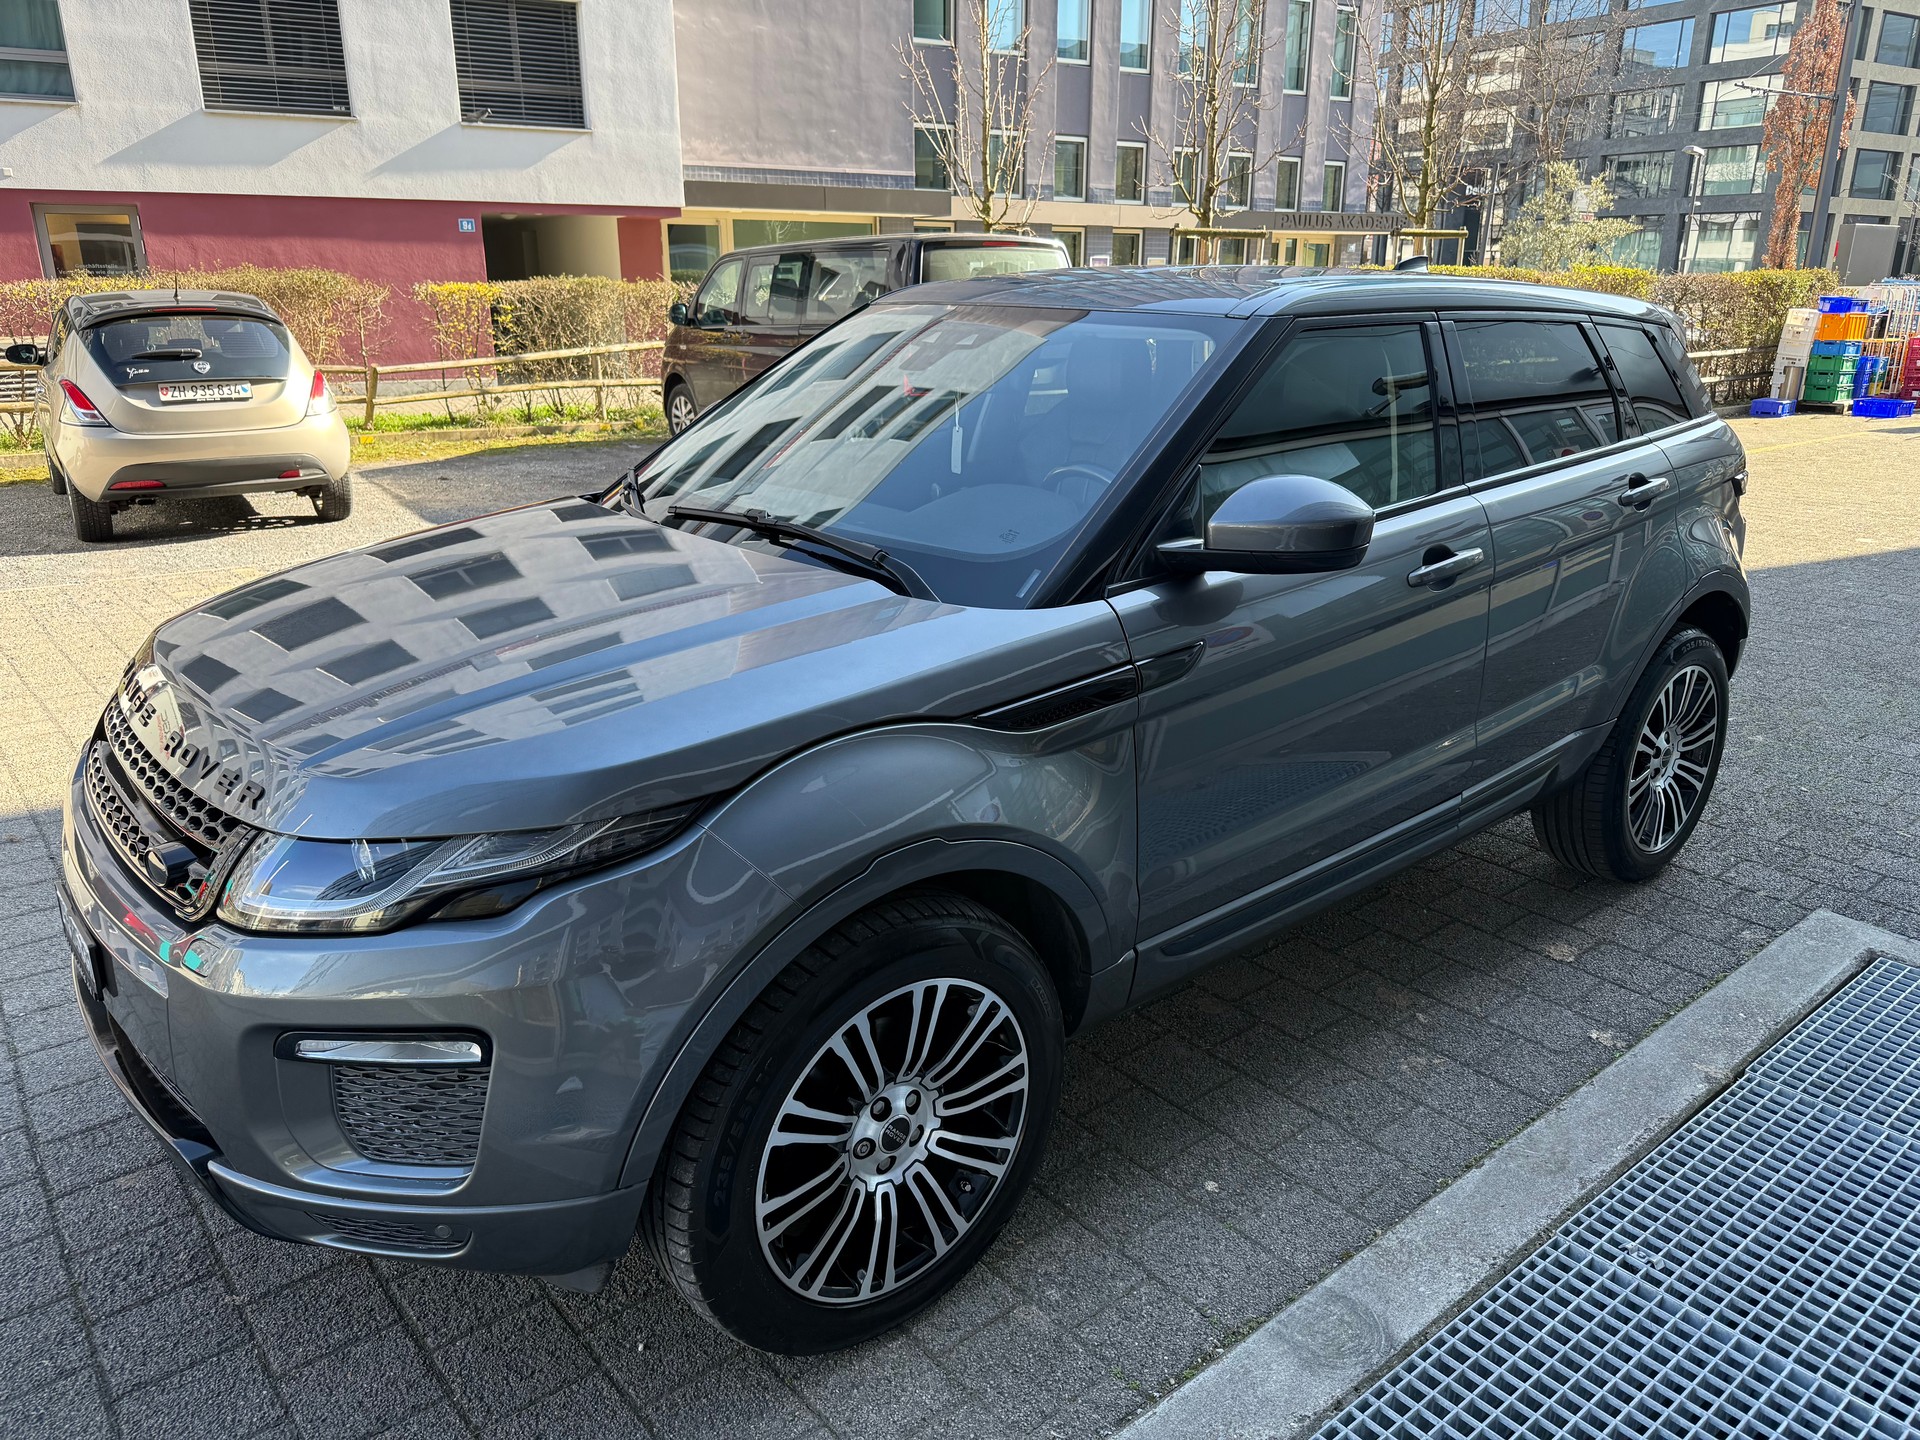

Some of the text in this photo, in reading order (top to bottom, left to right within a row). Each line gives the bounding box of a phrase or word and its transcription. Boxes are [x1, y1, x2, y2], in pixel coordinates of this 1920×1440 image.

[1280, 214, 1408, 230] PAULUS AKADEMIE
[163, 730, 266, 811] ROVER
[885, 1129, 904, 1144] ROVER
[887, 1124, 907, 1140] RANGE
